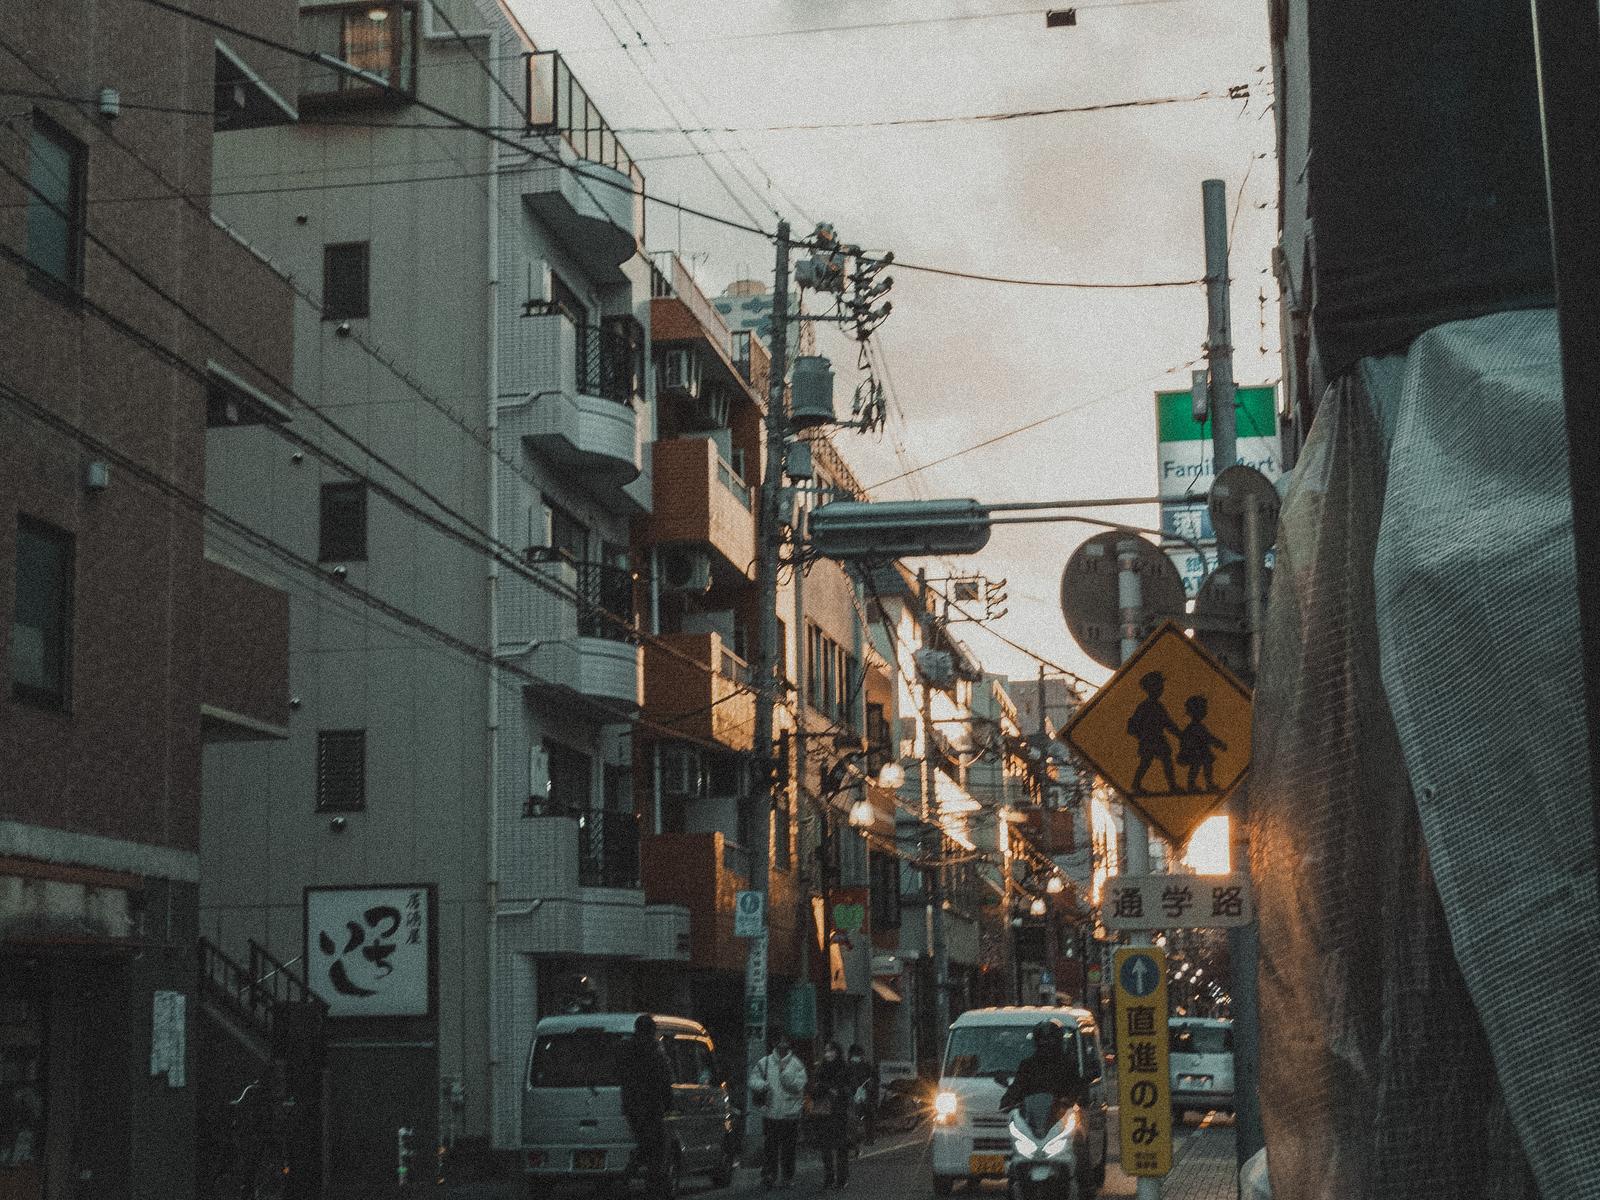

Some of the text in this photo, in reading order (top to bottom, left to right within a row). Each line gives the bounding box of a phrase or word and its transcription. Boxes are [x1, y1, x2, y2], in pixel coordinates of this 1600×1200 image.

[1112, 886, 1243, 918] 通学路
[1127, 1006, 1159, 1146] 直進のみ
